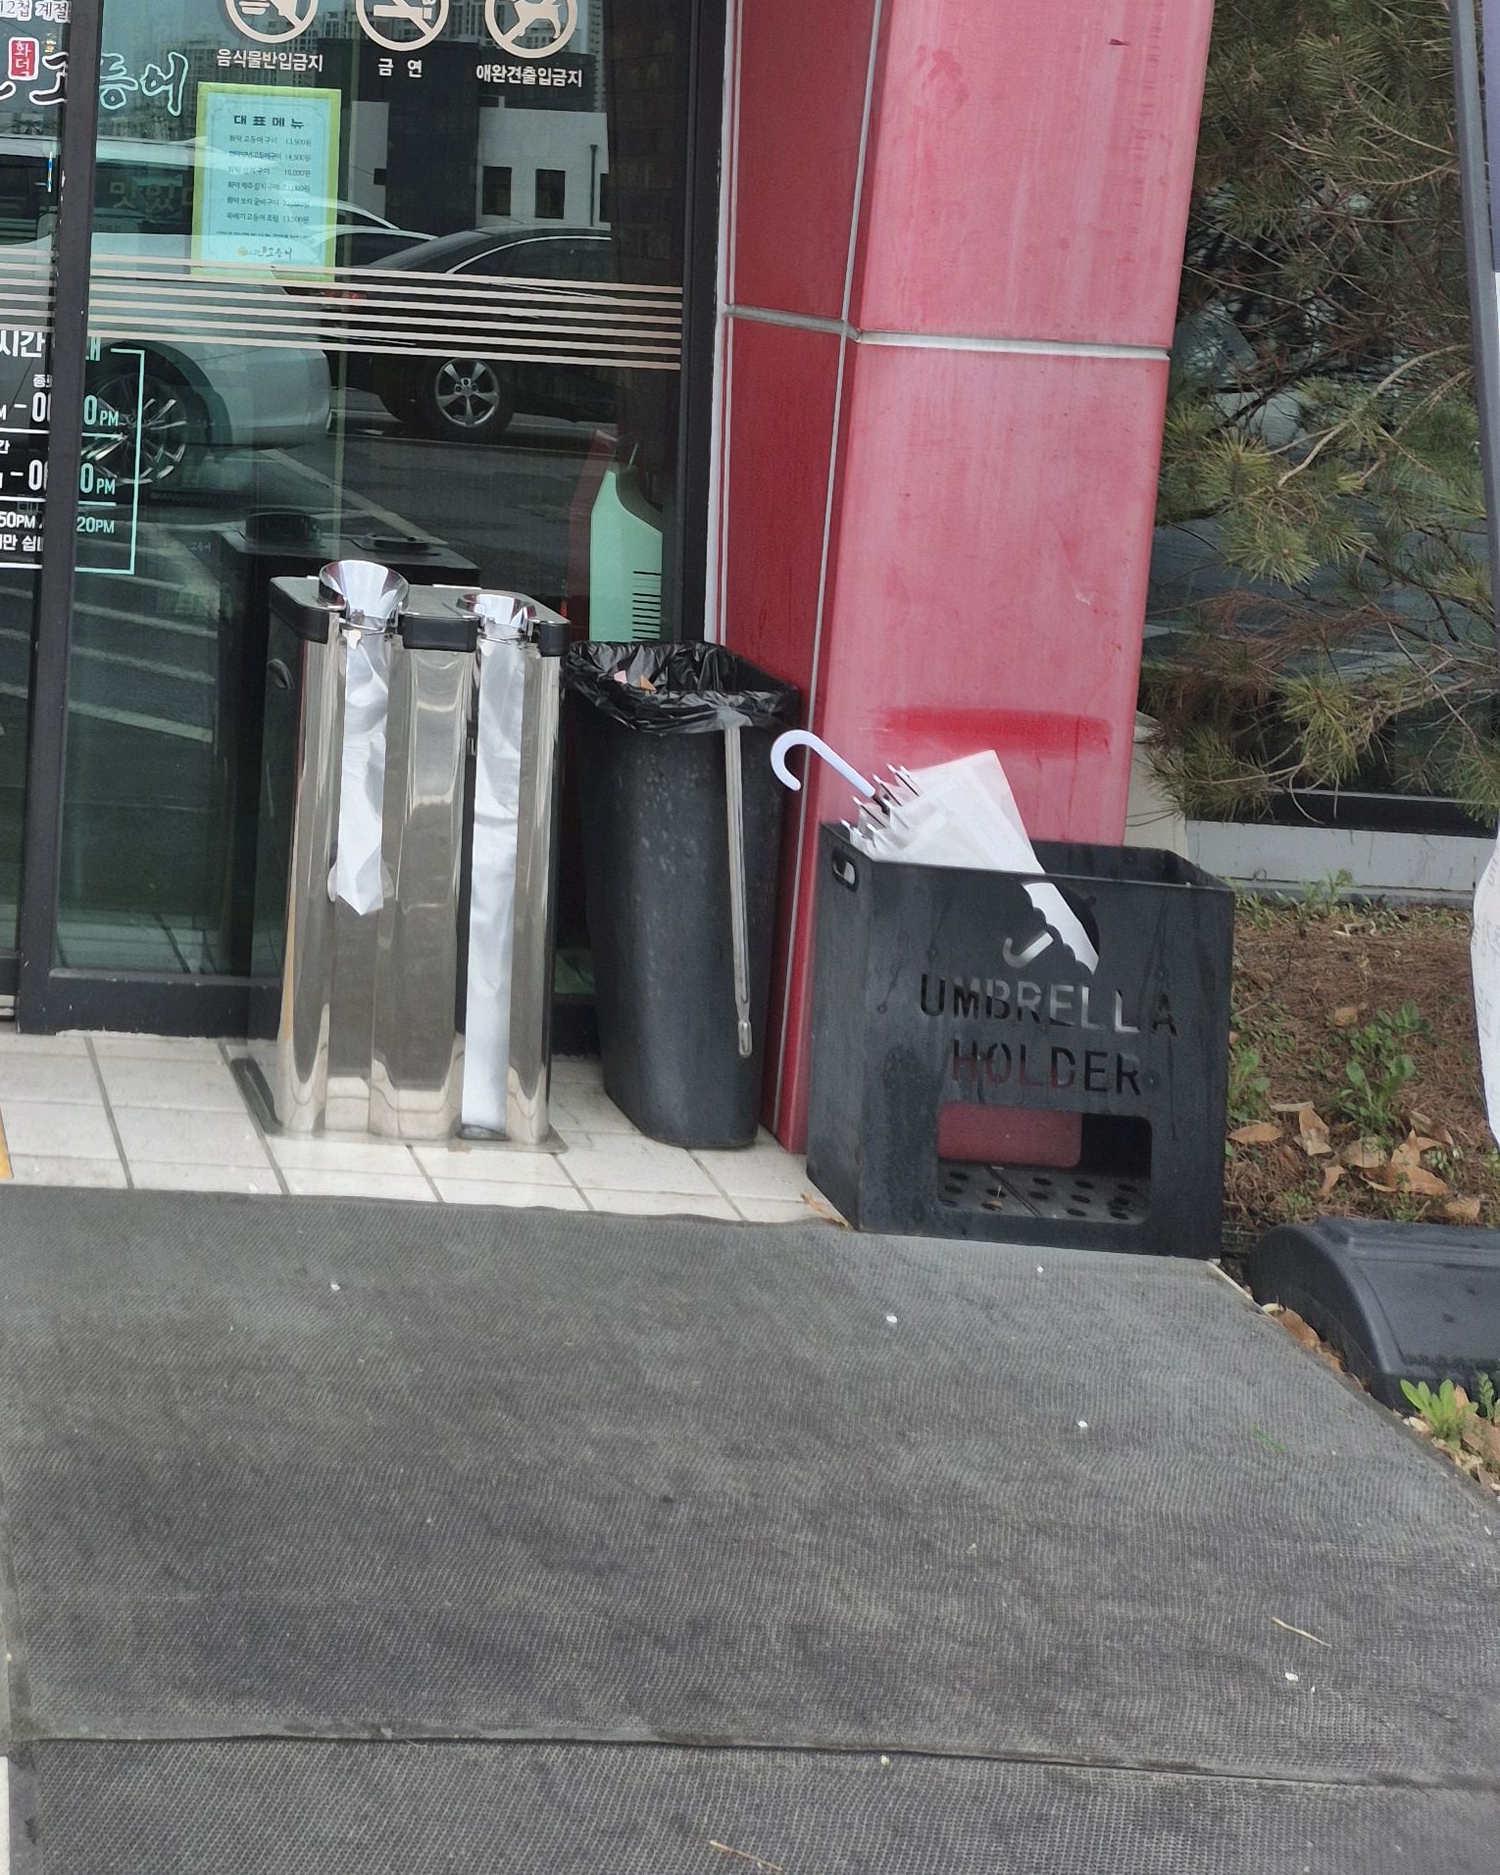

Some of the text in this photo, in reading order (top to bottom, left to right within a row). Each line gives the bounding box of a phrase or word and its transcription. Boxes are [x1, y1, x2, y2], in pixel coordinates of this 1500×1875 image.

[15, 41, 32, 76] 화덕
[216, 49, 323, 73] 음식물반입금지
[476, 64, 583, 88] 애완견출입금지
[920, 973, 1178, 1036] UMBRELLA
[951, 1040, 1142, 1097] HOLDER
